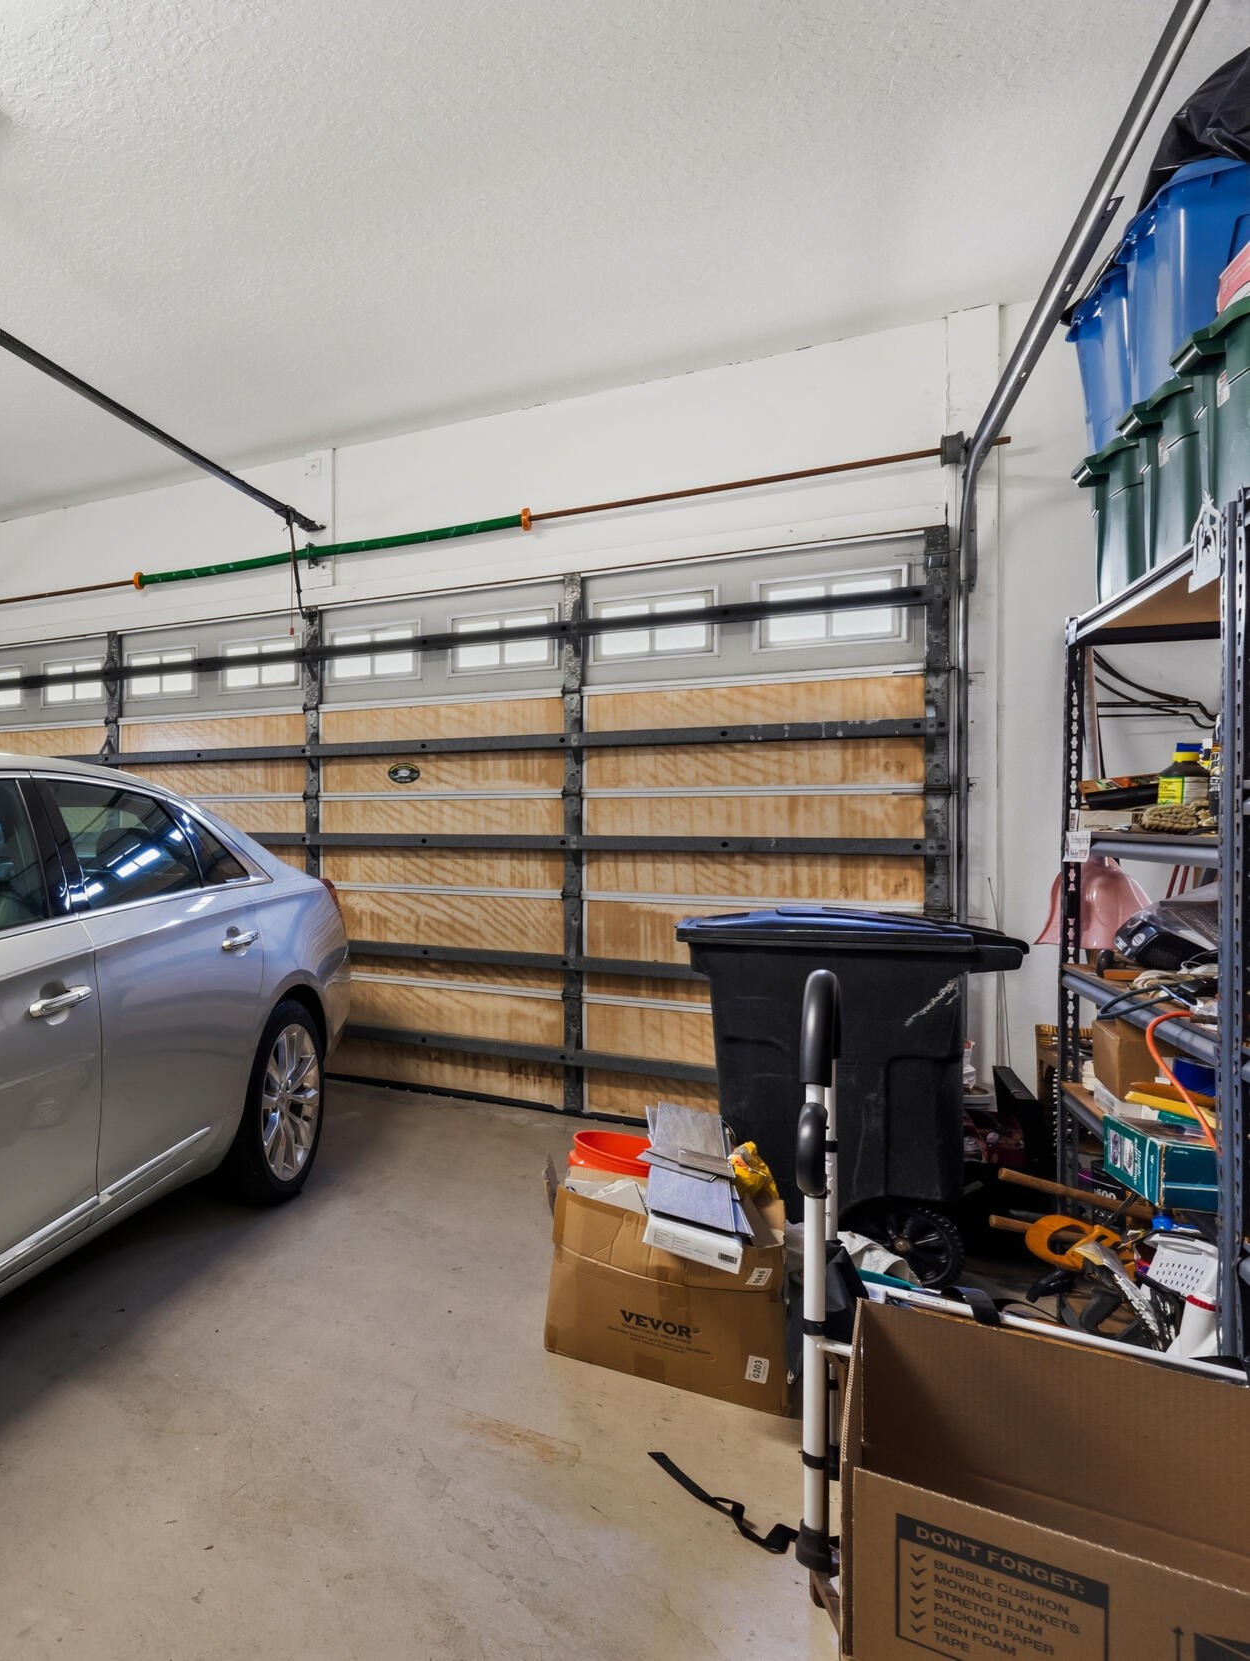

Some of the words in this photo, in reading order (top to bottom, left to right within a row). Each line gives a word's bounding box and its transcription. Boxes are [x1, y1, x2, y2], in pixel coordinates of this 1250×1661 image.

[619, 1309, 692, 1339] VEVOR
[916, 1525, 981, 1558] DON'T
[987, 1549, 1085, 1595] FORGET:
[934, 1559, 994, 1588] BUBBLE
[997, 1583, 1070, 1616] CUSHION
[934, 1574, 993, 1603] MOVING
[997, 1597, 1080, 1635] BLANKETS
[934, 1589, 1002, 1621] STRETCH
[1006, 1615, 1043, 1637] FILM
[934, 1603, 999, 1635] PACKING
[1003, 1629, 1055, 1656] PAPER
[934, 1617, 968, 1638] DISH
[972, 1632, 1017, 1657] FOAM
[934, 1631, 970, 1653] TAPE
